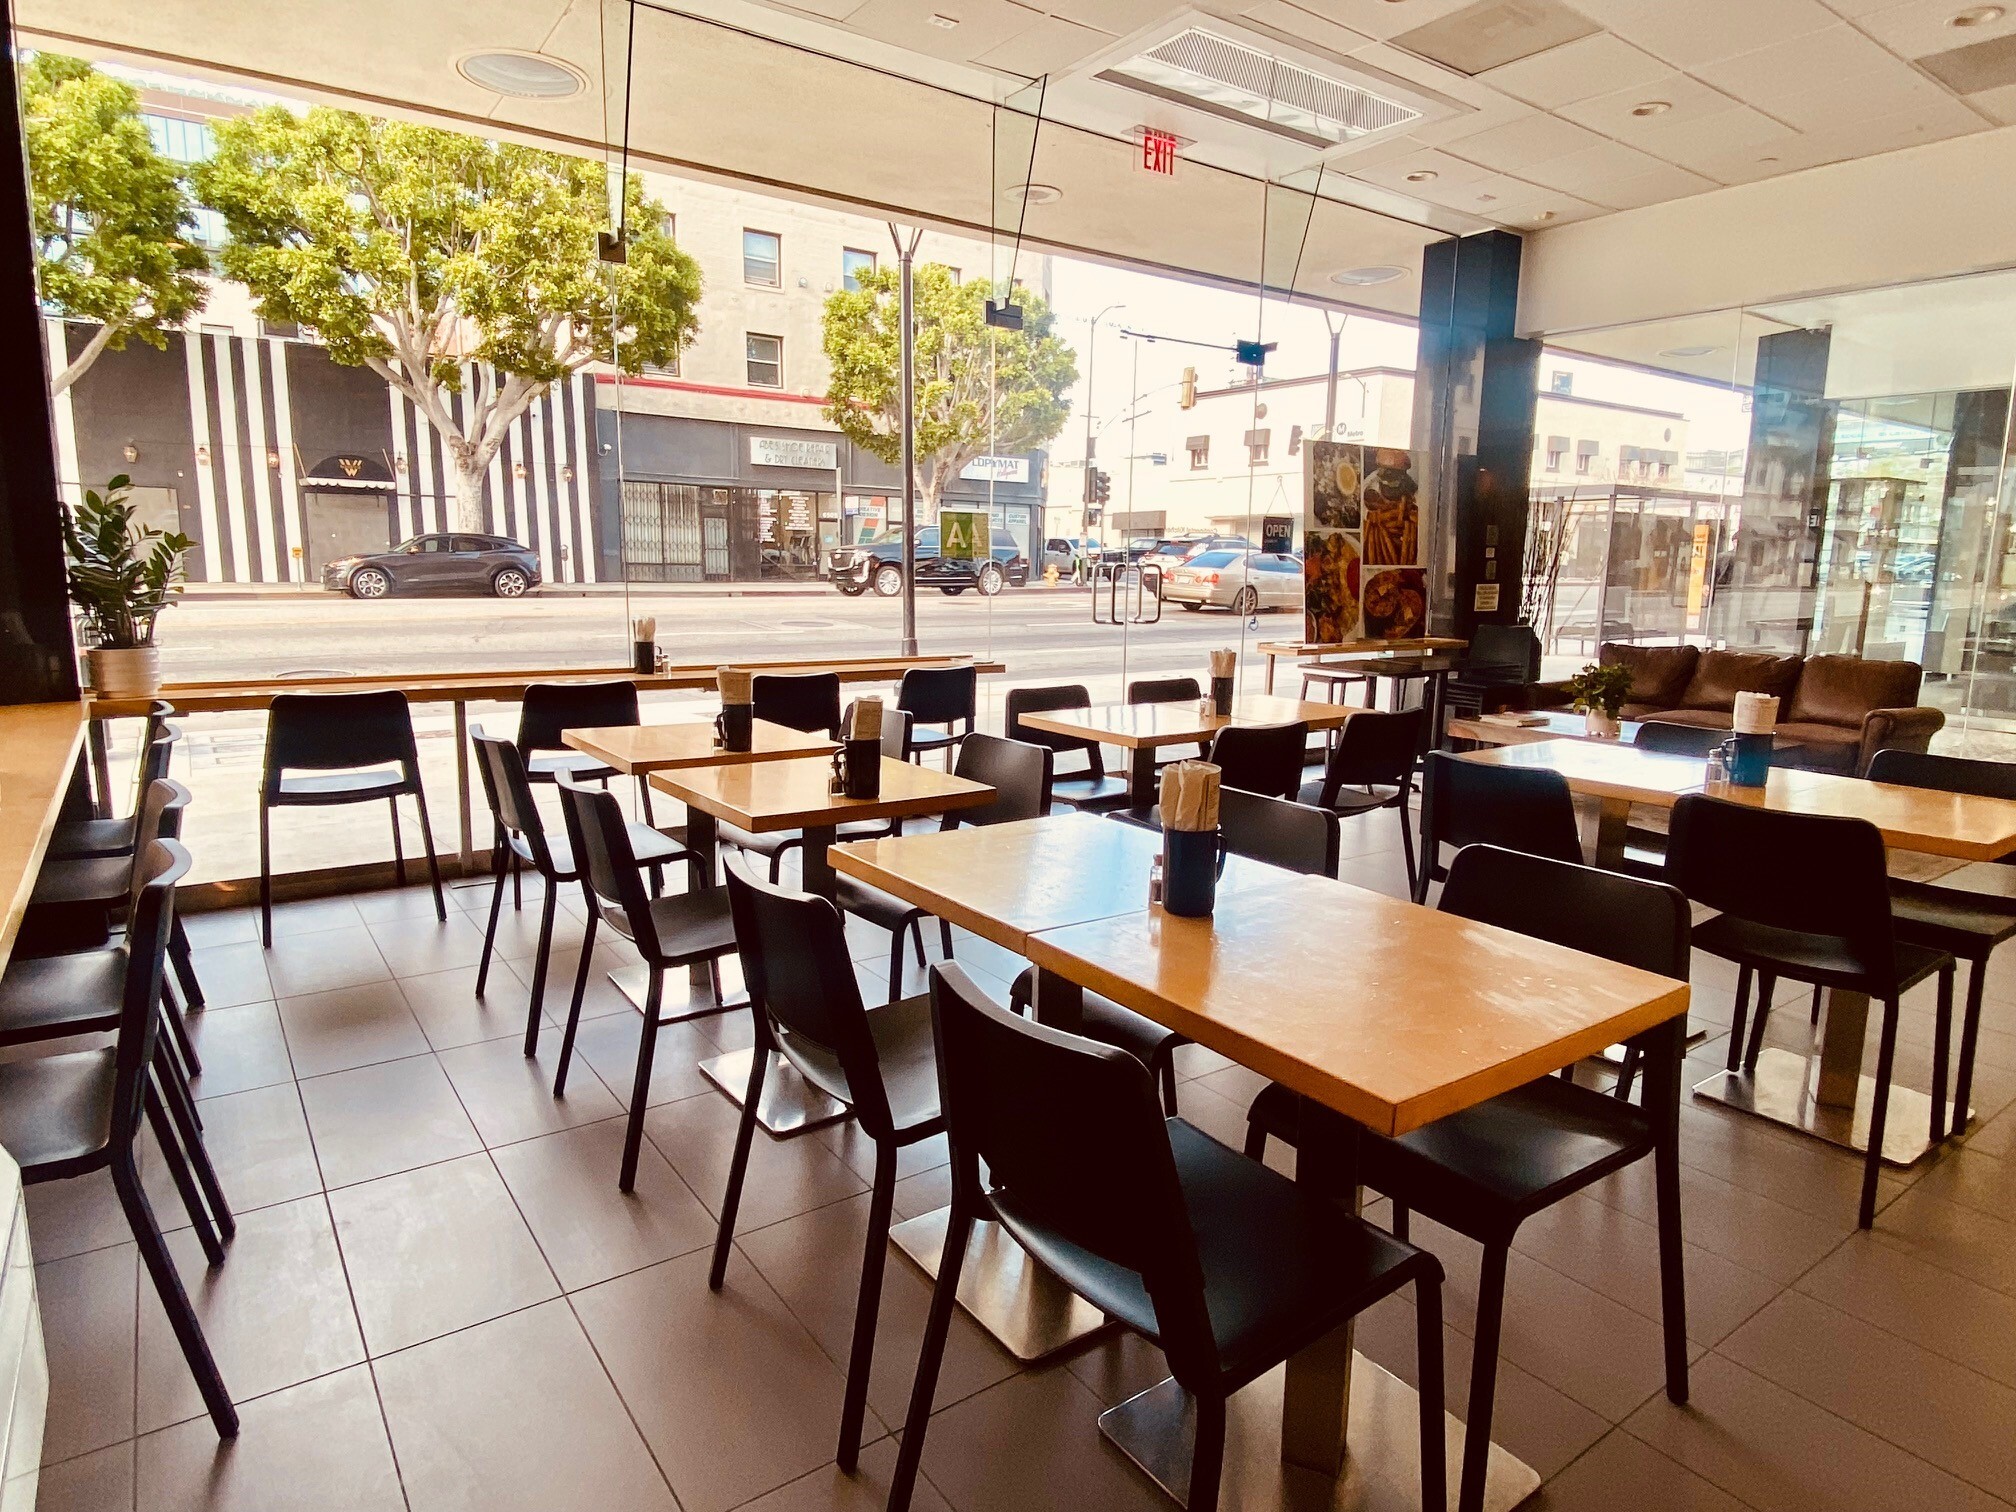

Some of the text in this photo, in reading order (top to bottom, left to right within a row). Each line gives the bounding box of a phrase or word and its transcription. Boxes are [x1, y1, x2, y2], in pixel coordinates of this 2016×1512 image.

[1144, 136, 1176, 175] EXIT
[972, 459, 1019, 470] COPYMAT
[946, 521, 966, 548] A
[1265, 524, 1291, 538] OPEN
